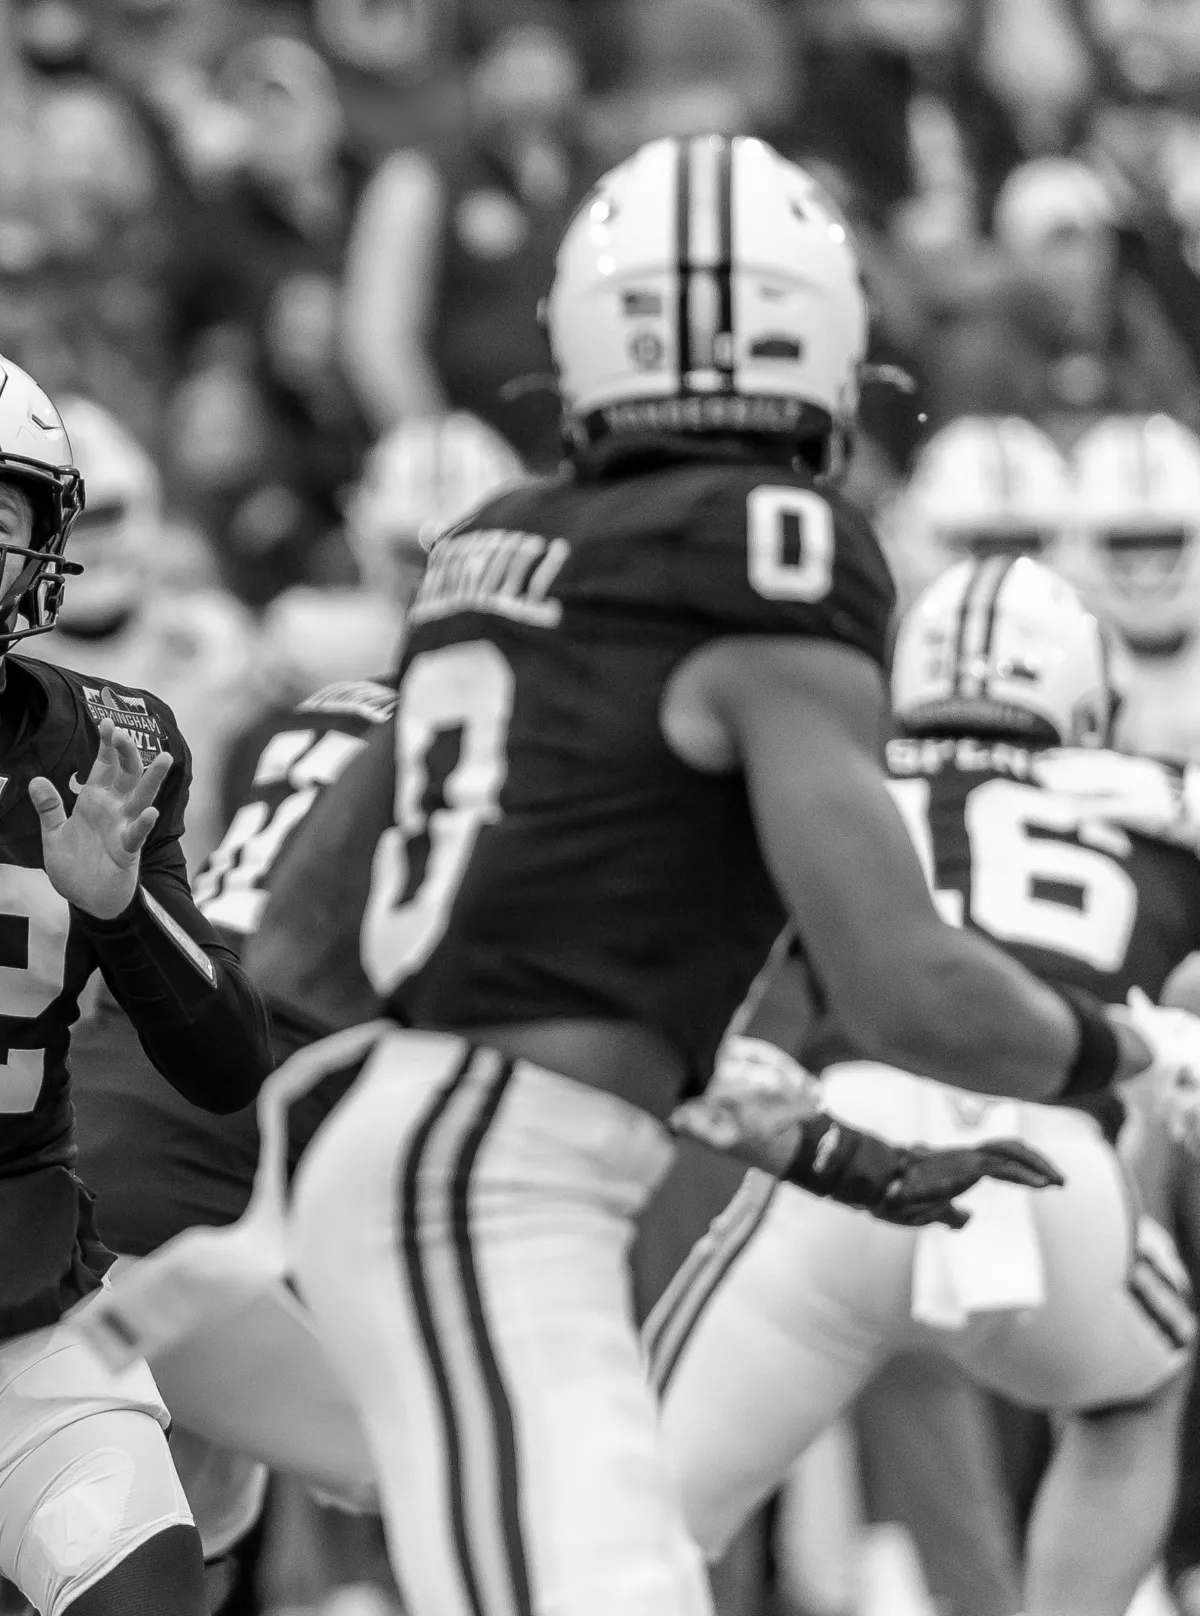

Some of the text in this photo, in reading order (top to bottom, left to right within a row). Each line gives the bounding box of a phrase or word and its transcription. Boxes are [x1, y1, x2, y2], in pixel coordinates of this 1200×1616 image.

[745, 483, 835, 602] 0
[87, 703, 161, 735] BIRMINGHAM
[359, 640, 516, 998] 0
